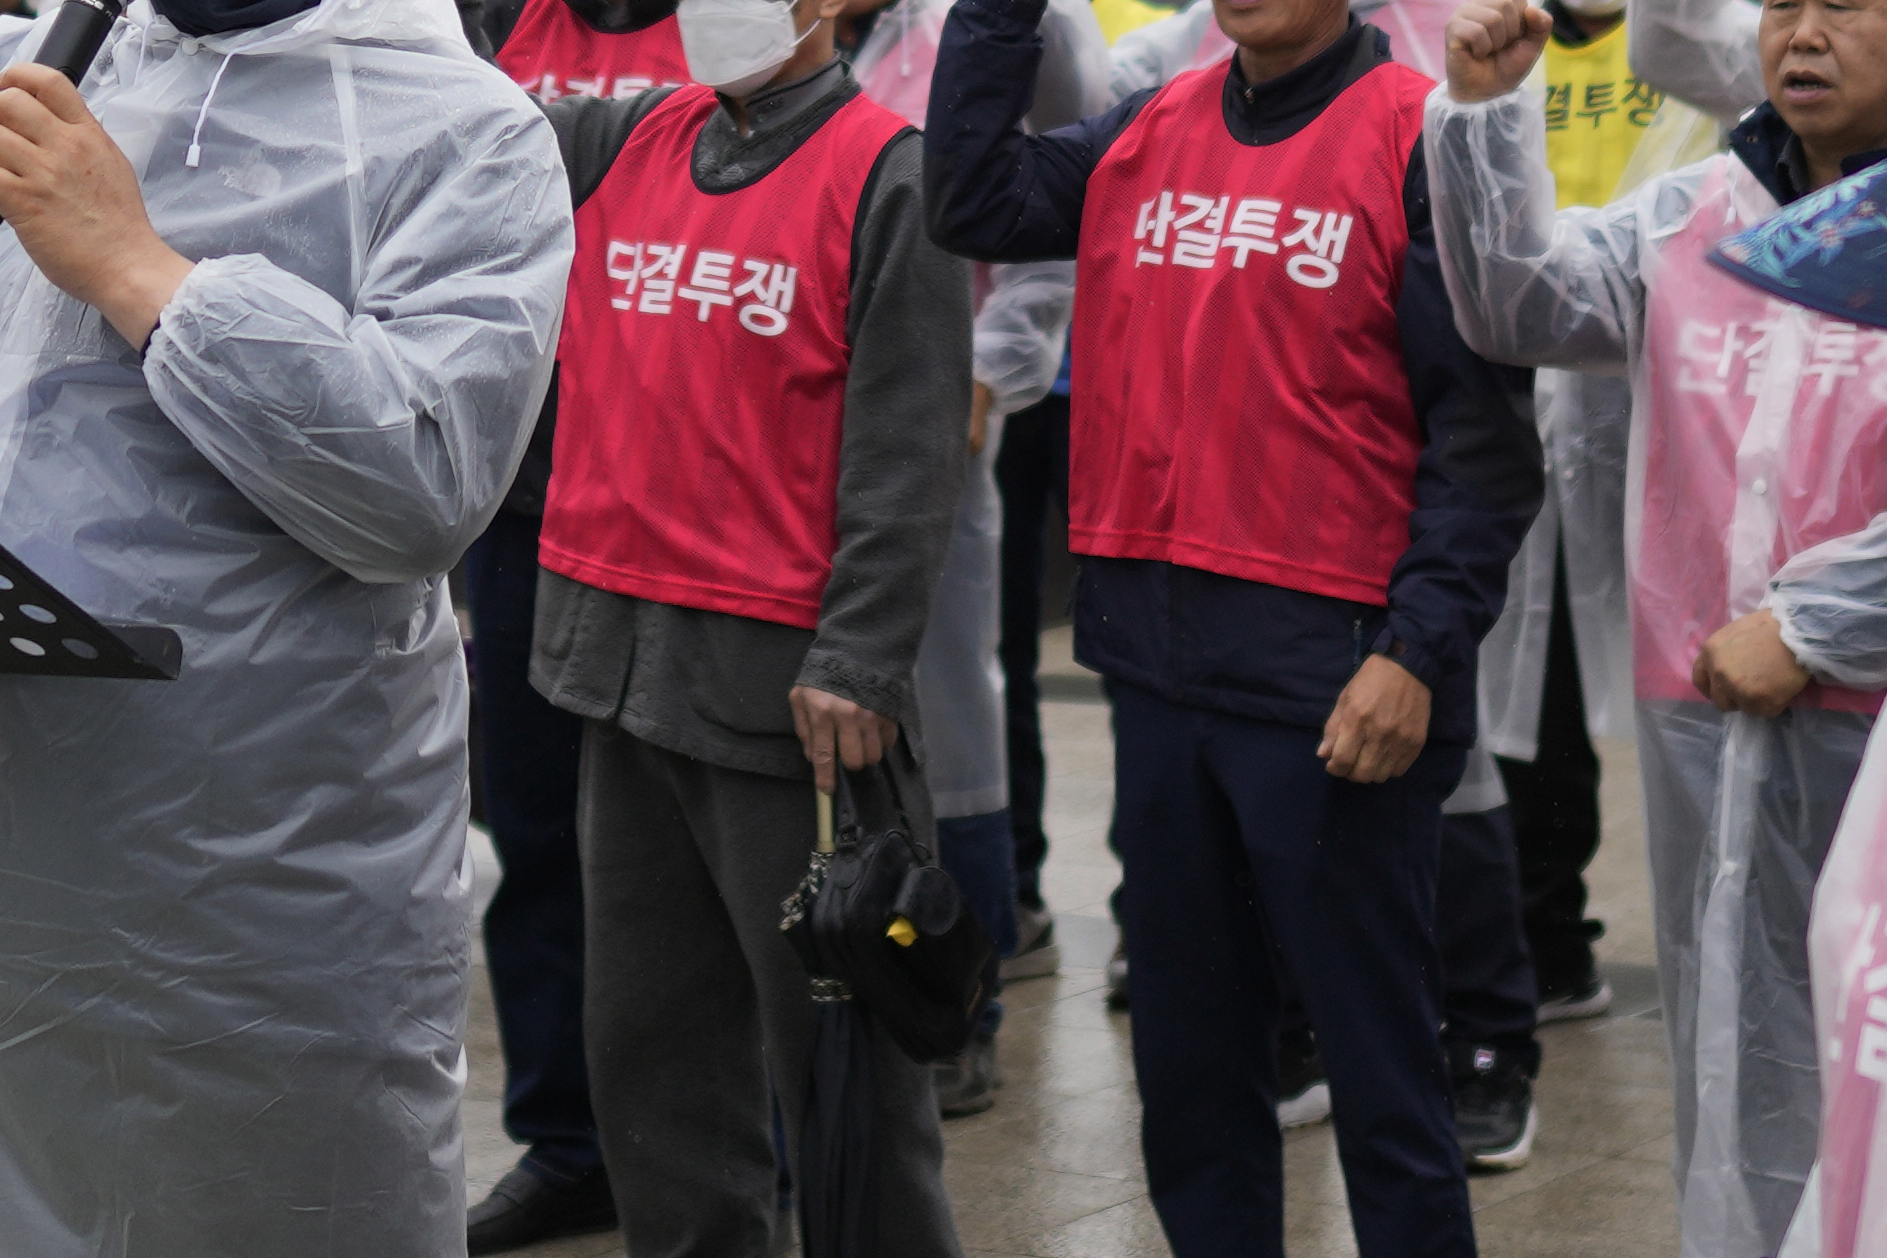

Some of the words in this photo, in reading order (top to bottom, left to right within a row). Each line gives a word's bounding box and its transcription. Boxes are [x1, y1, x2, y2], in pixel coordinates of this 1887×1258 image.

[1546, 77, 1667, 132] 결투쟁
[1134, 190, 1354, 289] 단결투쟁
[607, 240, 799, 337] 단결투쟁
